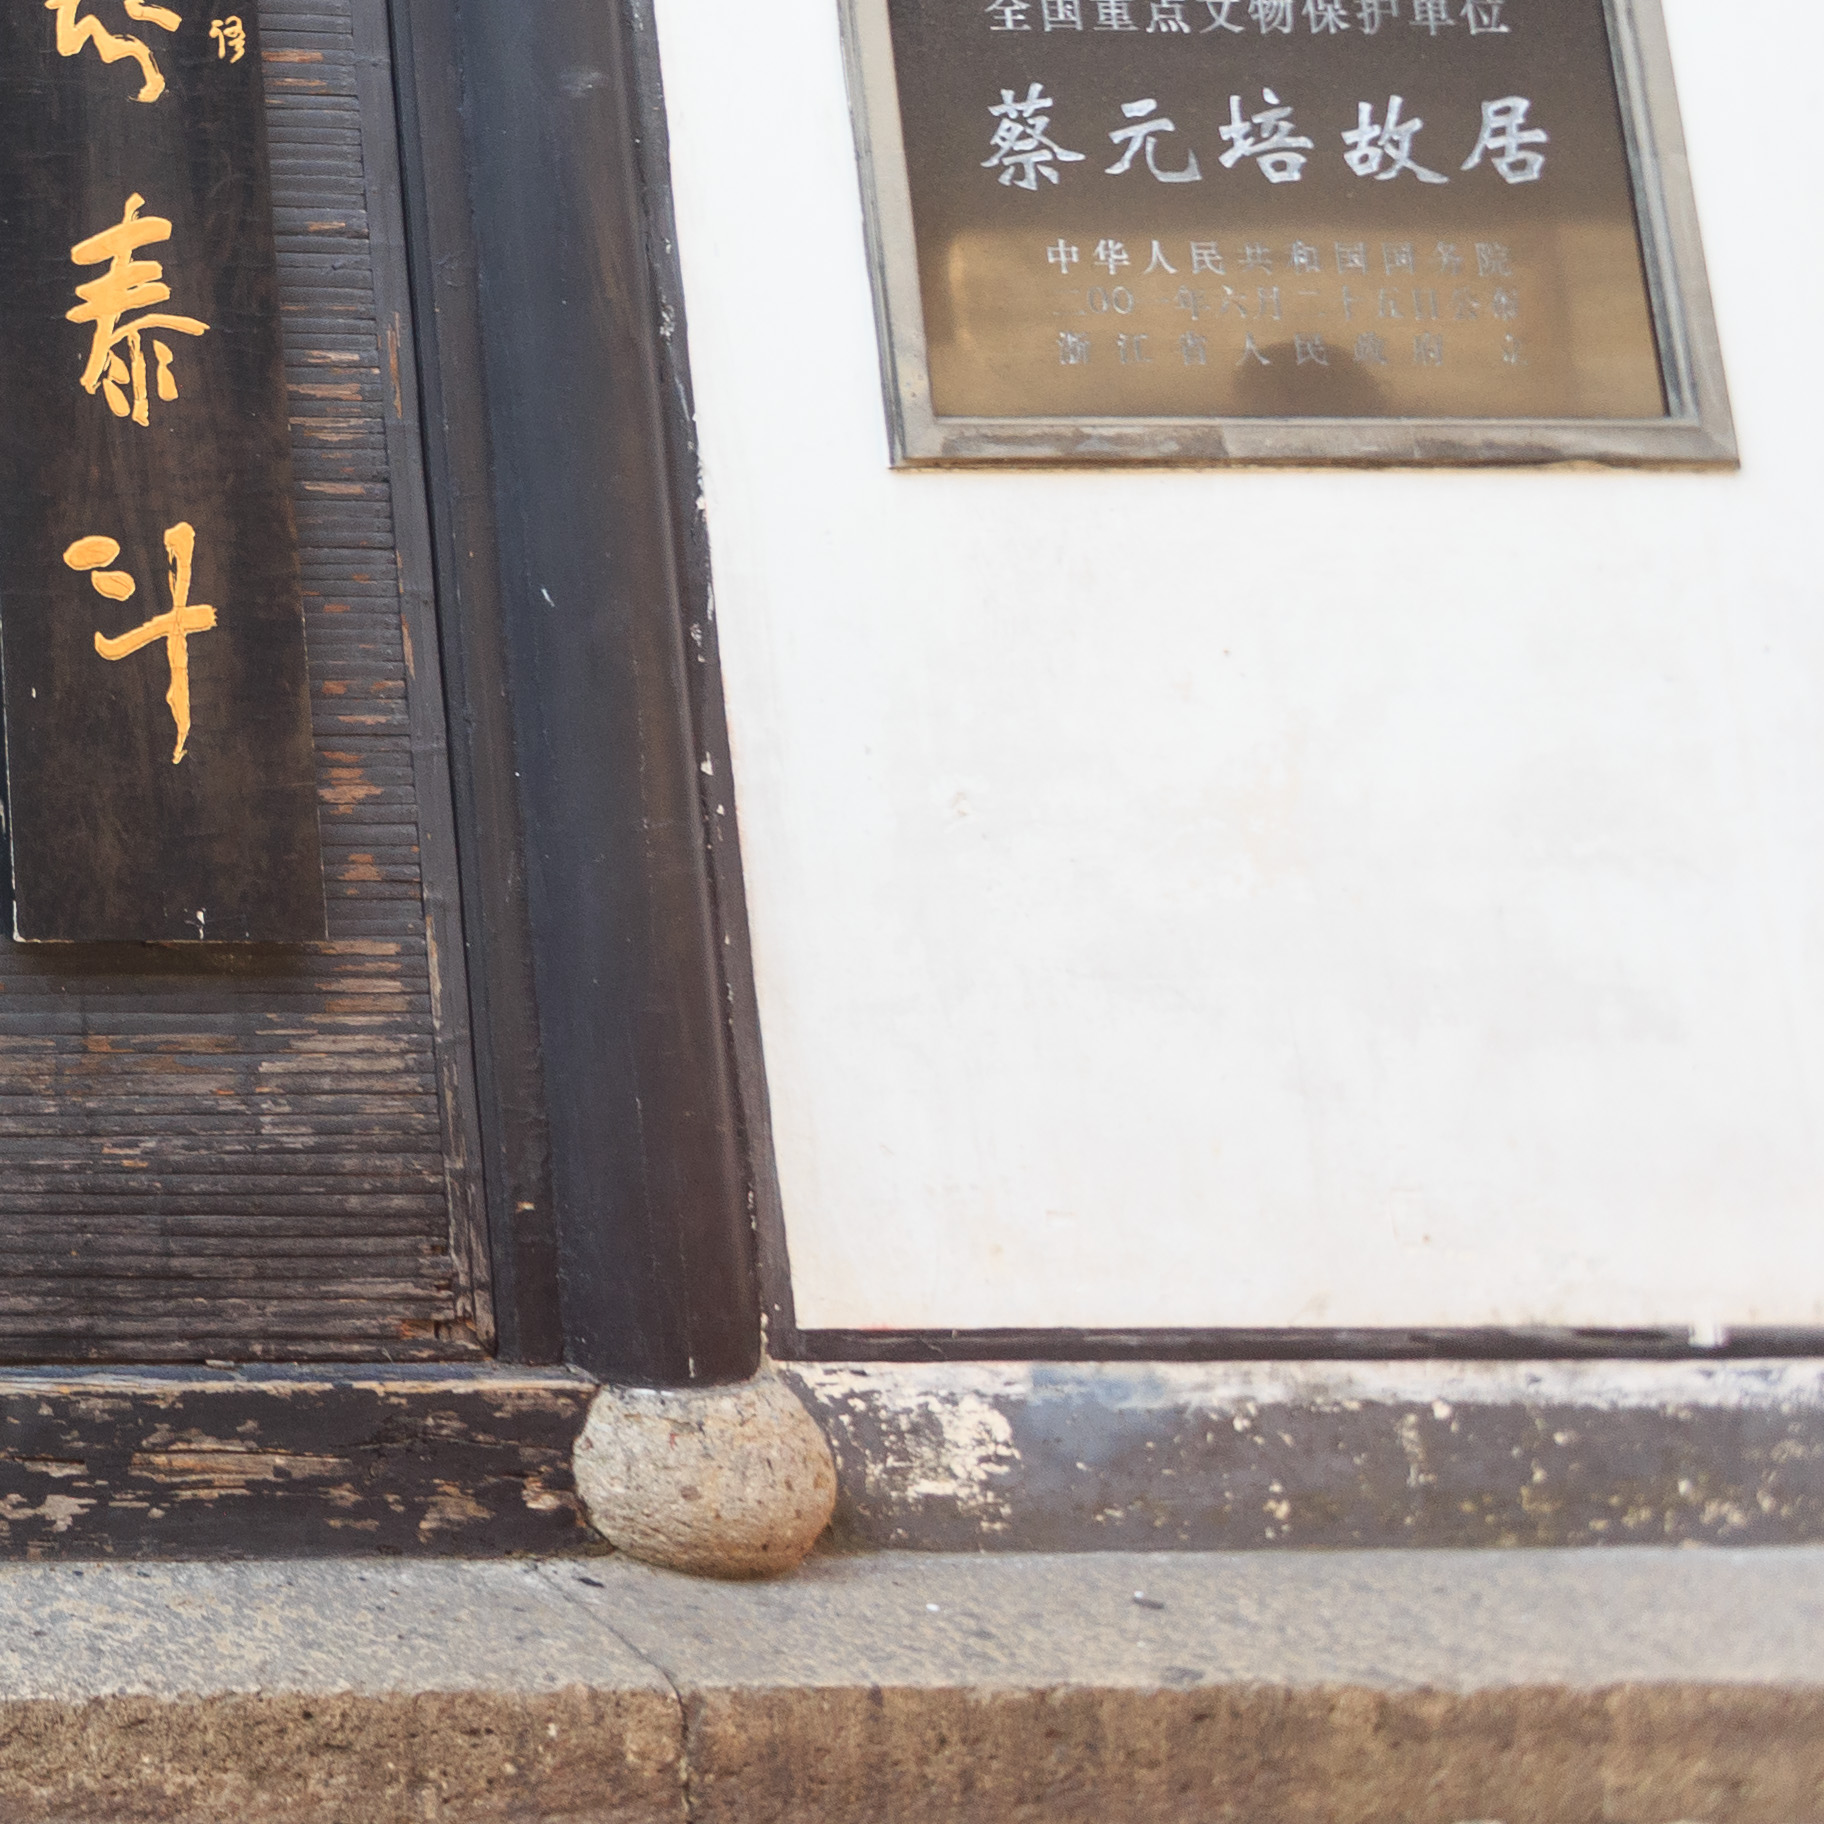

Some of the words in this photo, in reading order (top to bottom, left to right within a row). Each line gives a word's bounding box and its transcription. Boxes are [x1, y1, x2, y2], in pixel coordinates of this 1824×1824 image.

[980, 82, 1551, 191] 蔡元培故居
[1045, 238, 1515, 278] 中华人民共和国国务院
